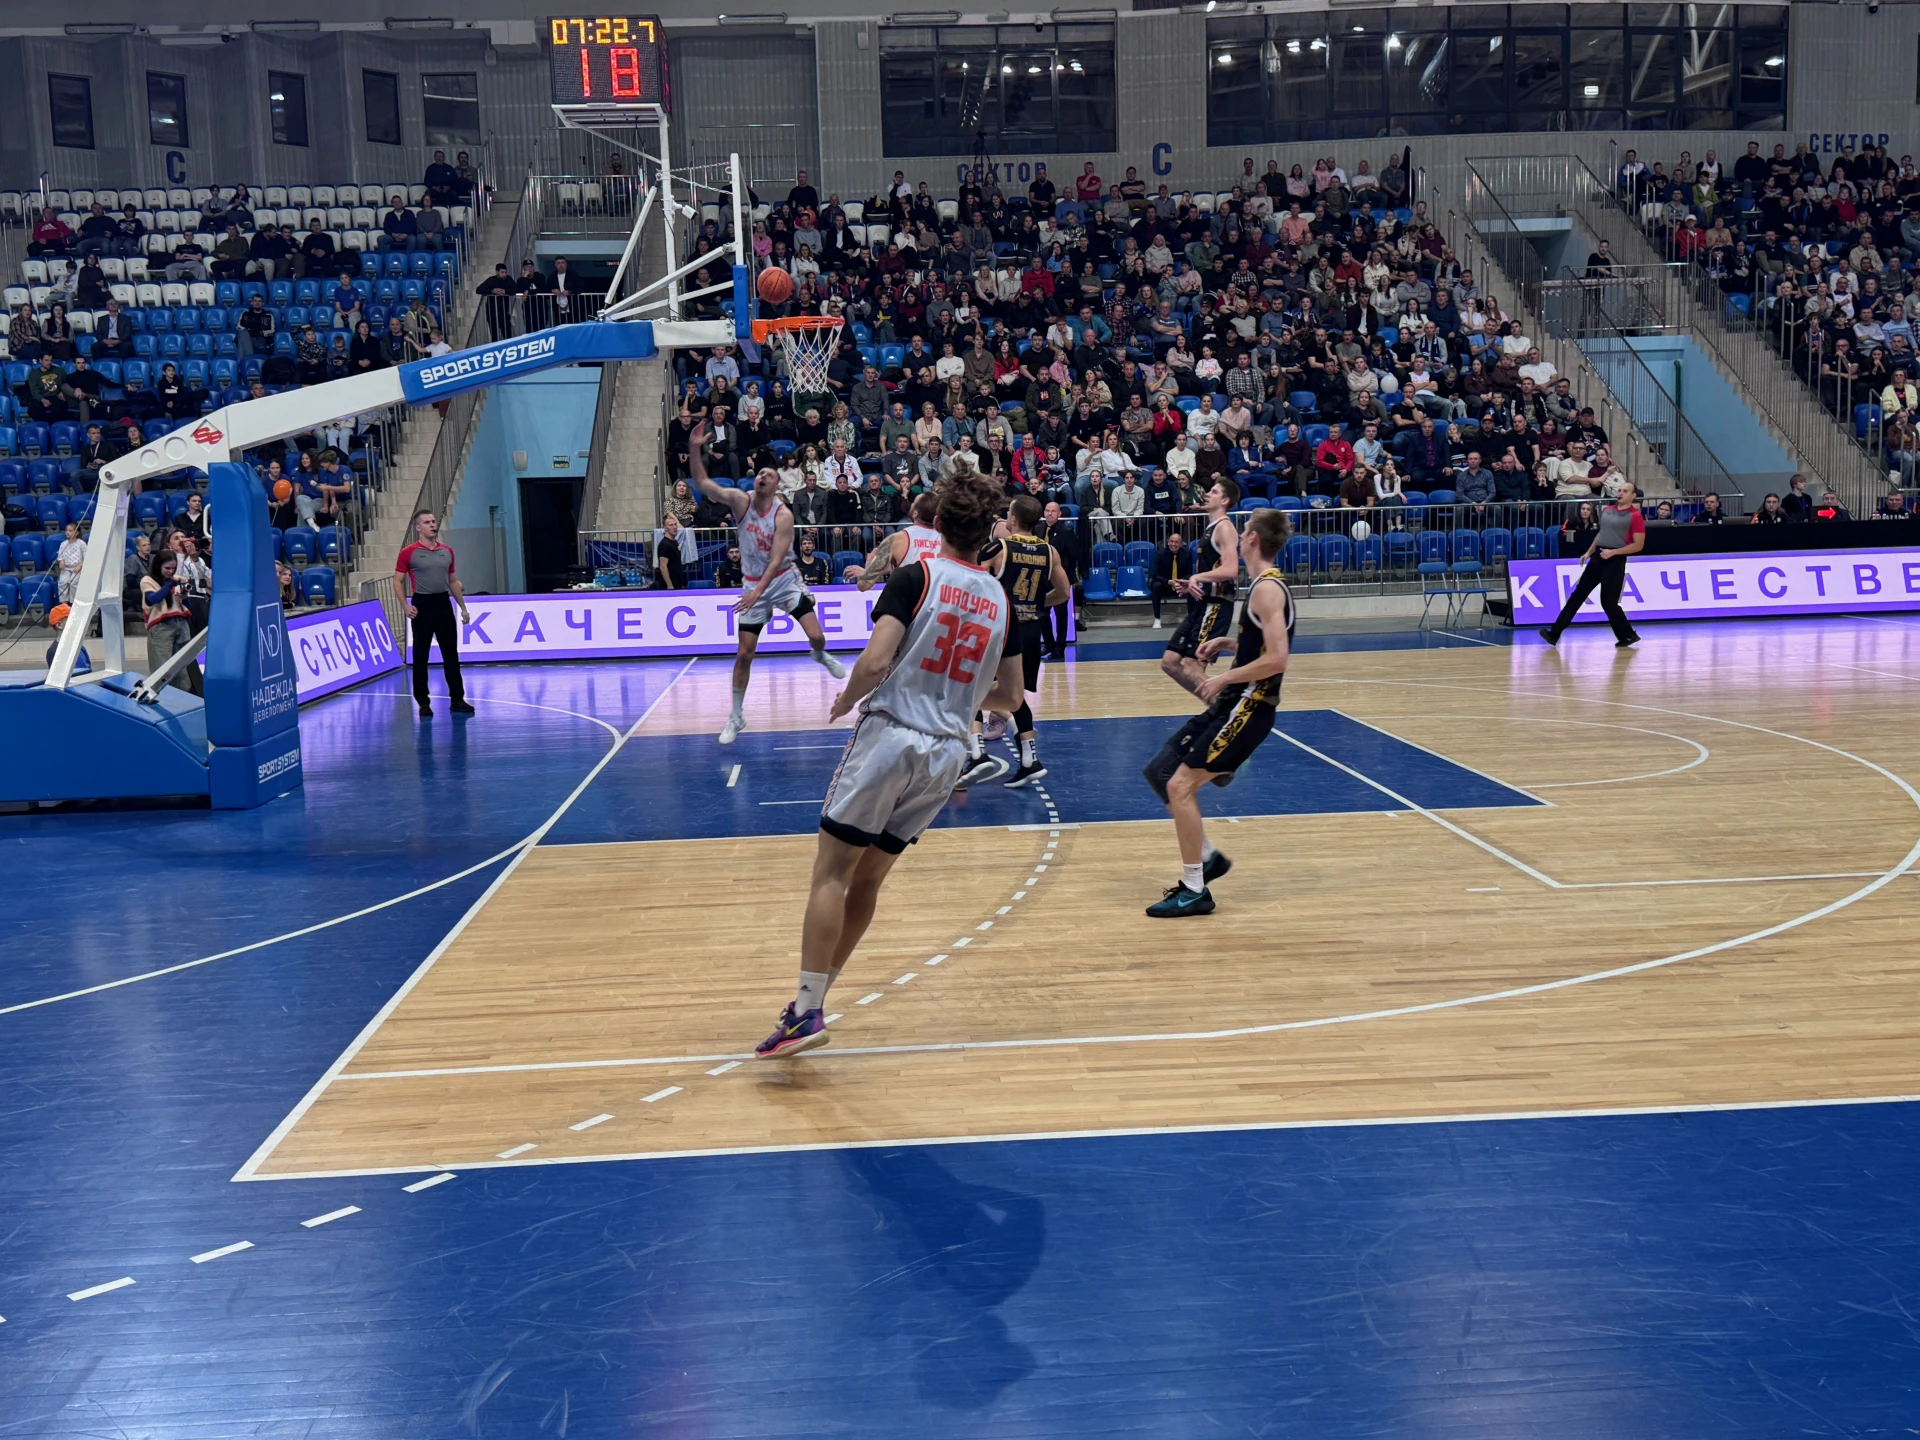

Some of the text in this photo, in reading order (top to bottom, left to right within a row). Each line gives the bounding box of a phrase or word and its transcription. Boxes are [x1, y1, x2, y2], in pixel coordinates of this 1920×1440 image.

[551, 18, 655, 45] 07:22.7
[581, 48, 641, 97] 18
[940, 583, 999, 622] ШАДУРО
[1012, 567, 1042, 602] 41
[920, 611, 992, 684] 32
[251, 678, 294, 708] НАДЕЖДА
